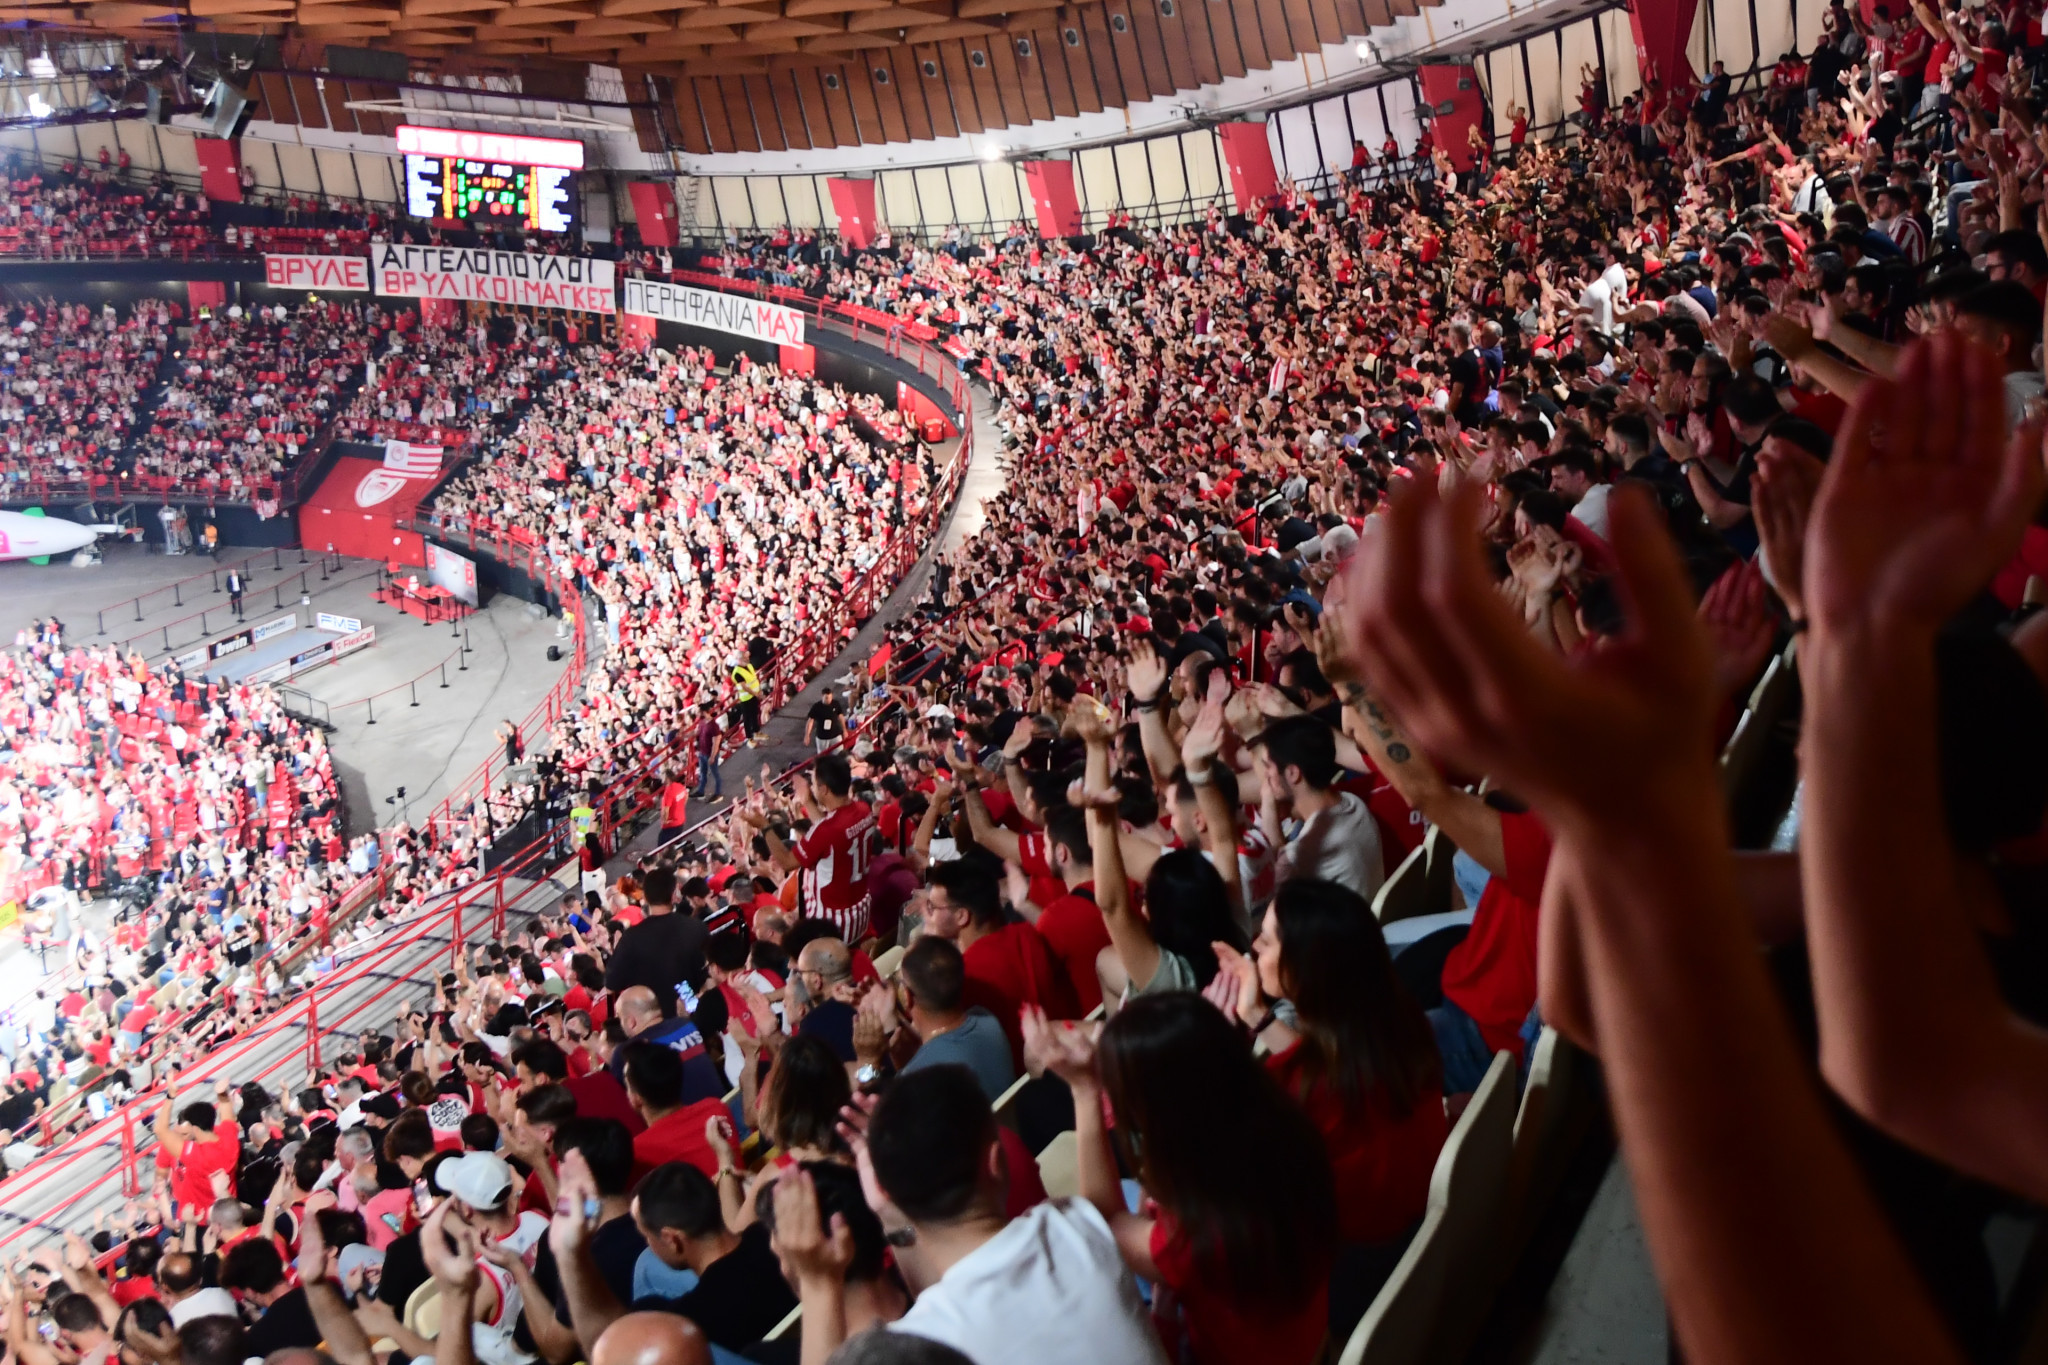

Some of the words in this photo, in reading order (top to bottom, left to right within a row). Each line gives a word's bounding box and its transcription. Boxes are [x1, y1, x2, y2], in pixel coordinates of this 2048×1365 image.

[381, 244, 592, 283] ΑΓΓΕΛΟΠΟΥΛΟΙ
[215, 635, 248, 657] bwin
[343, 631, 373, 648] FlexCar
